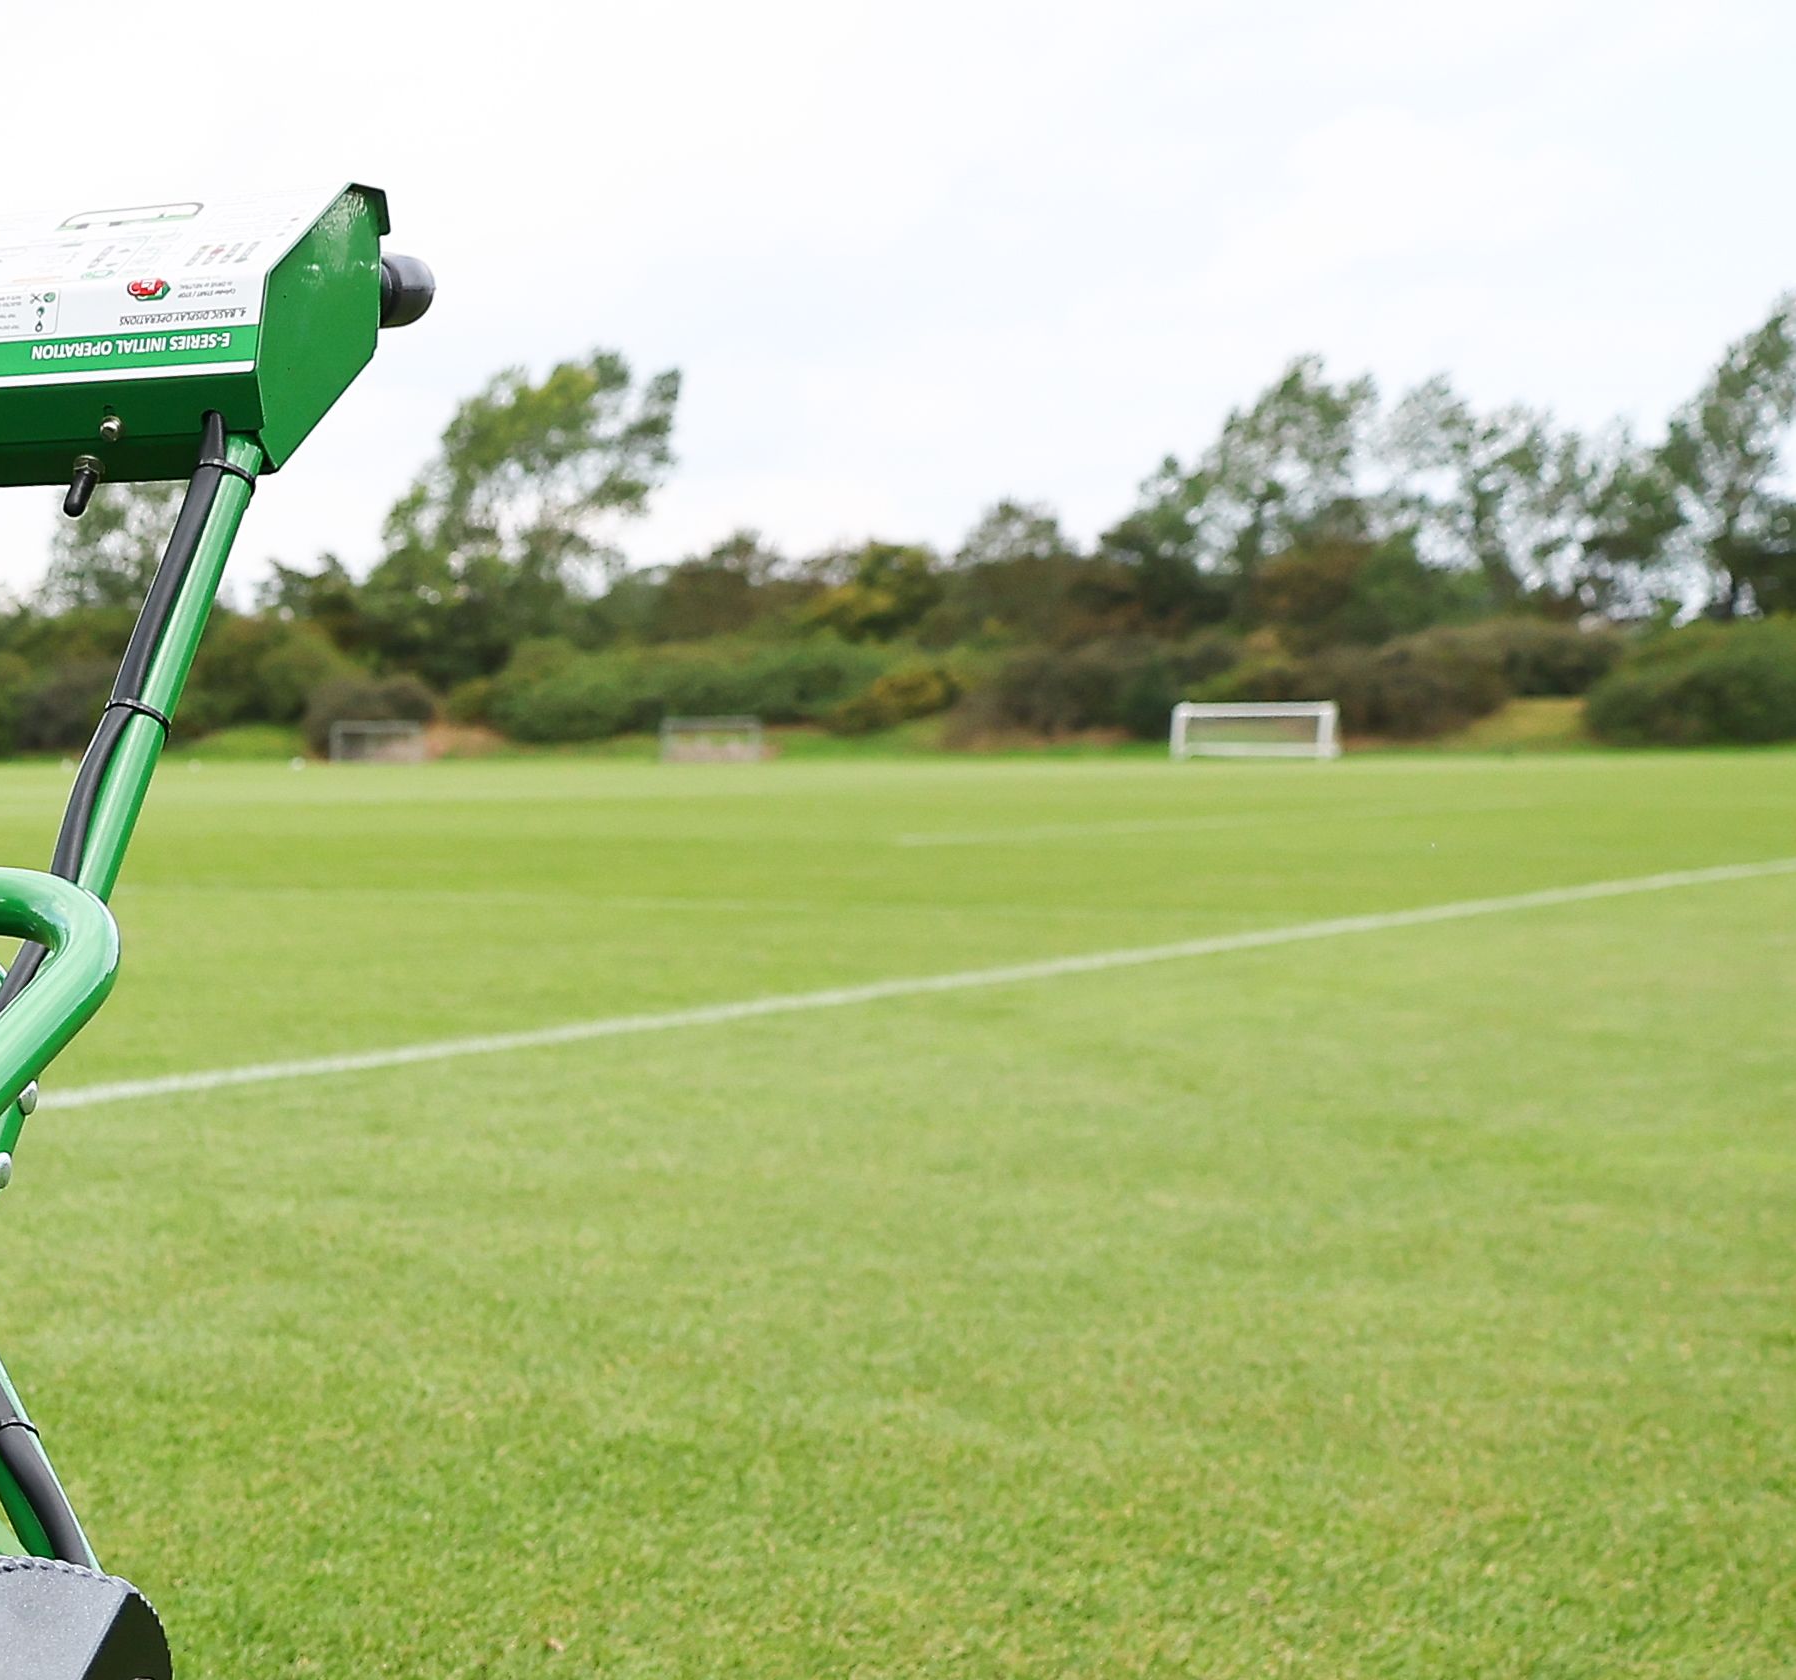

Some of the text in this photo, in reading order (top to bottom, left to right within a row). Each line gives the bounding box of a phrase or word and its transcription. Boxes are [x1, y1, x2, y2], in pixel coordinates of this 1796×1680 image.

[119, 312, 173, 325] OPERATIONS
[174, 310, 210, 322] DISPLAY
[210, 308, 237, 319] BASIC
[31, 332, 231, 360] E-SERIES INITIAL OPERATION
